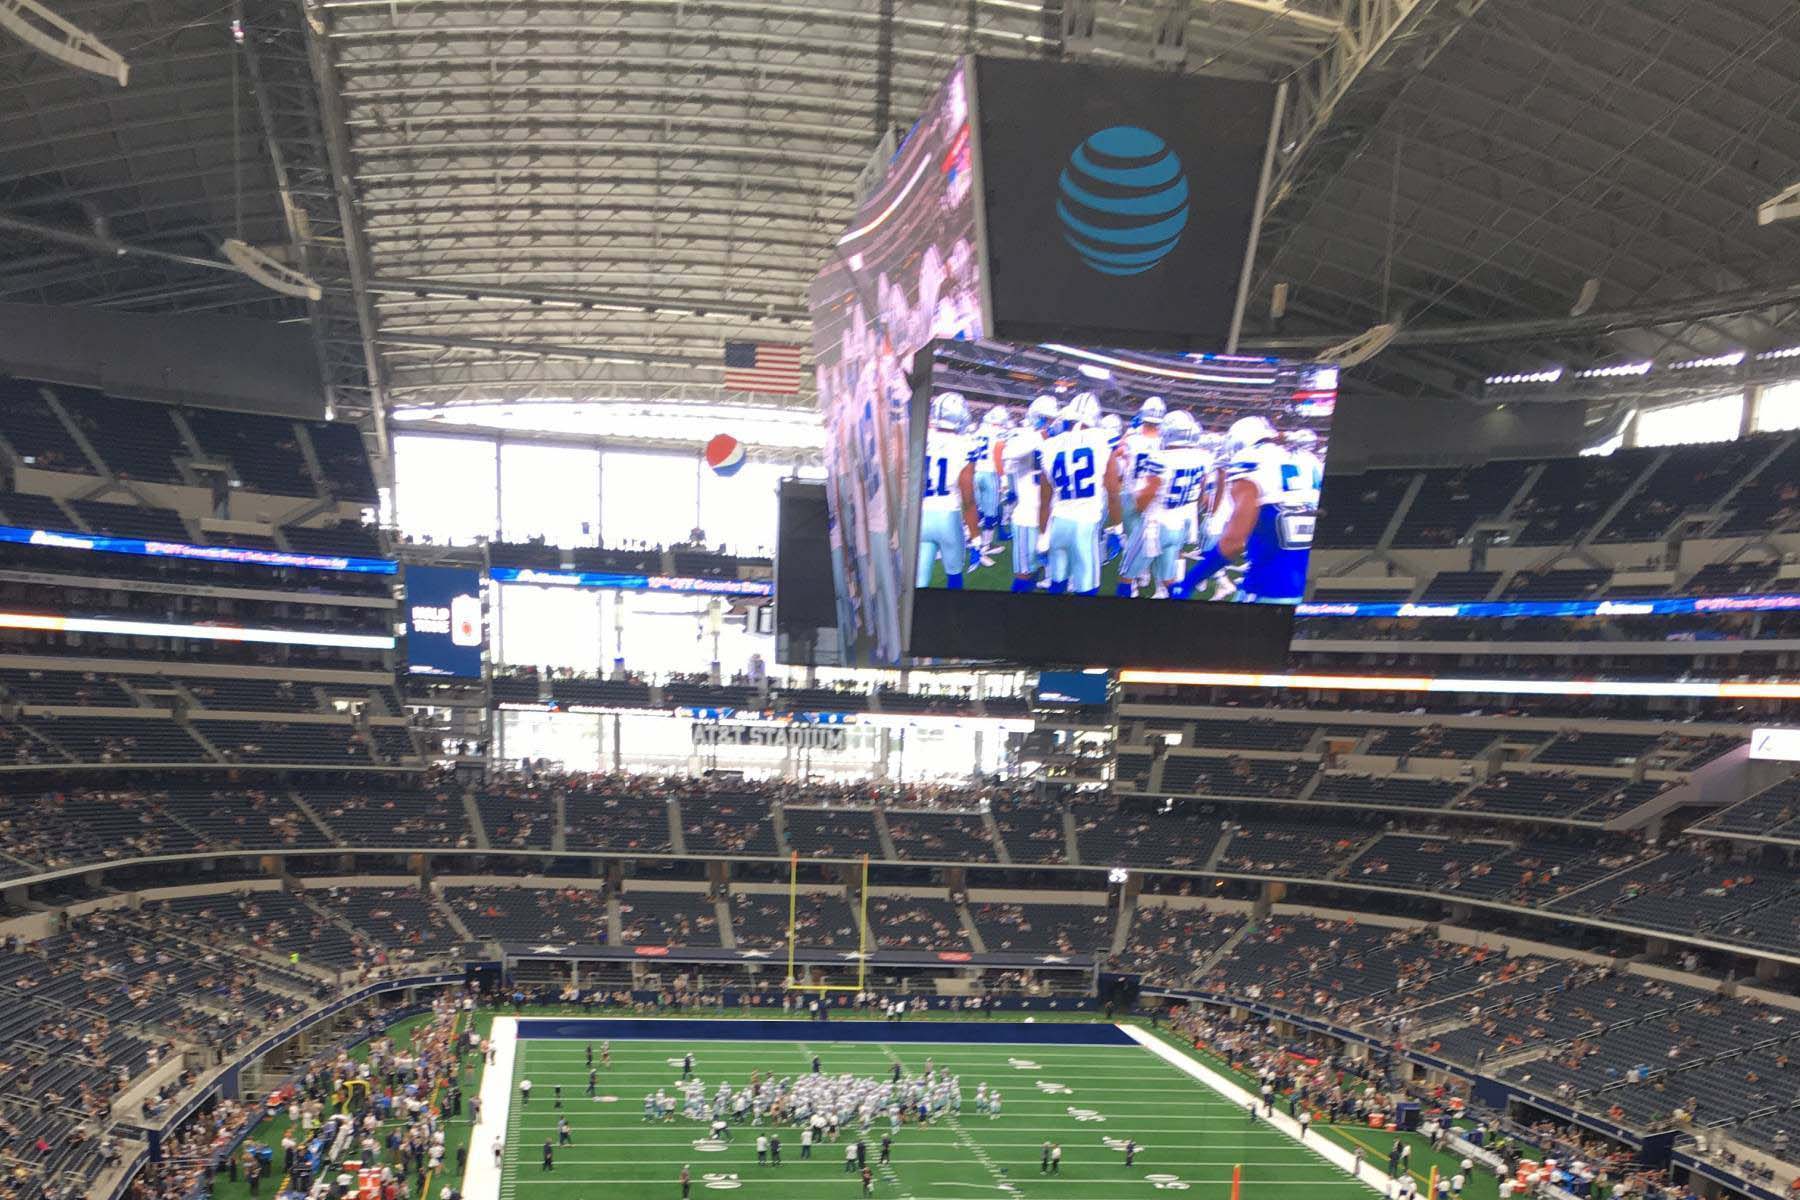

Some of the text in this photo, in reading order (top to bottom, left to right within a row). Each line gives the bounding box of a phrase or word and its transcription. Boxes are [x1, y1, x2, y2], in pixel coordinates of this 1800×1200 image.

[1052, 447, 1096, 501] 42
[692, 723, 846, 751] AT&T STADIUM
